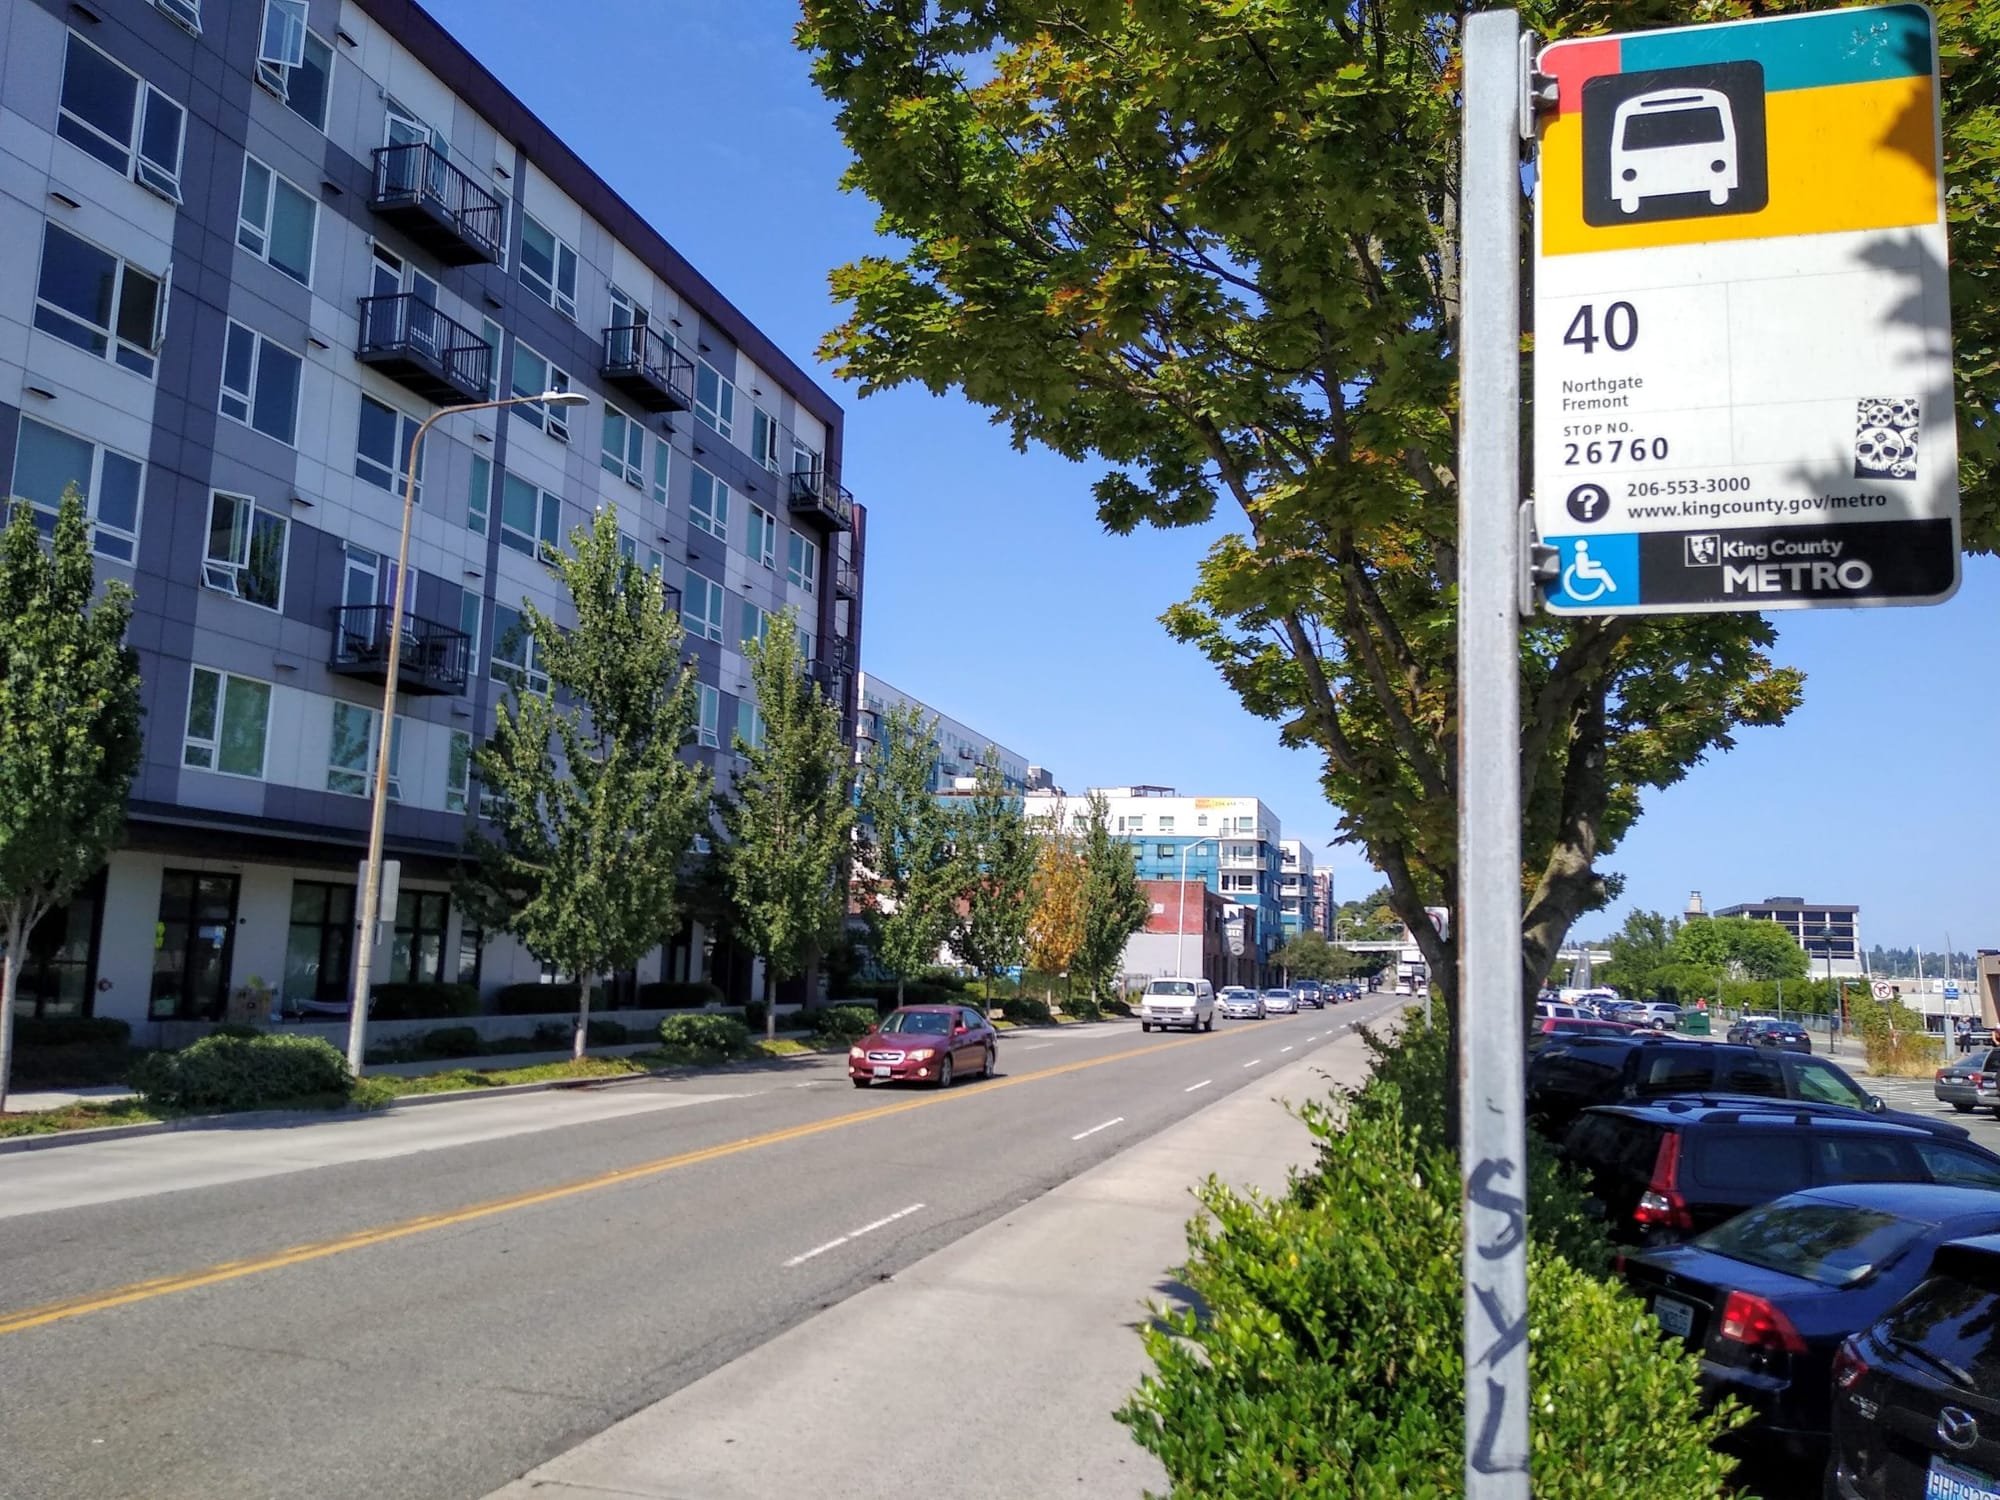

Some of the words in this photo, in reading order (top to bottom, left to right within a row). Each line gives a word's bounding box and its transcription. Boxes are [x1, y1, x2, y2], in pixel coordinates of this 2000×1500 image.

[1563, 300, 1639, 354] 40
[1562, 376, 1644, 394] Northgate
[1562, 394, 1630, 411] Fremont
[1563, 423, 1603, 437] STOP
[1606, 421, 1635, 435] NO.
[1564, 436, 1669, 466] 26760
[1627, 476, 1751, 498] 206-553-3000
[1627, 493, 1888, 519] www.kingcounty.gov/metro
[1722, 538, 1769, 561] King
[1770, 538, 1844, 558] County
[1722, 558, 1874, 594] METRO
